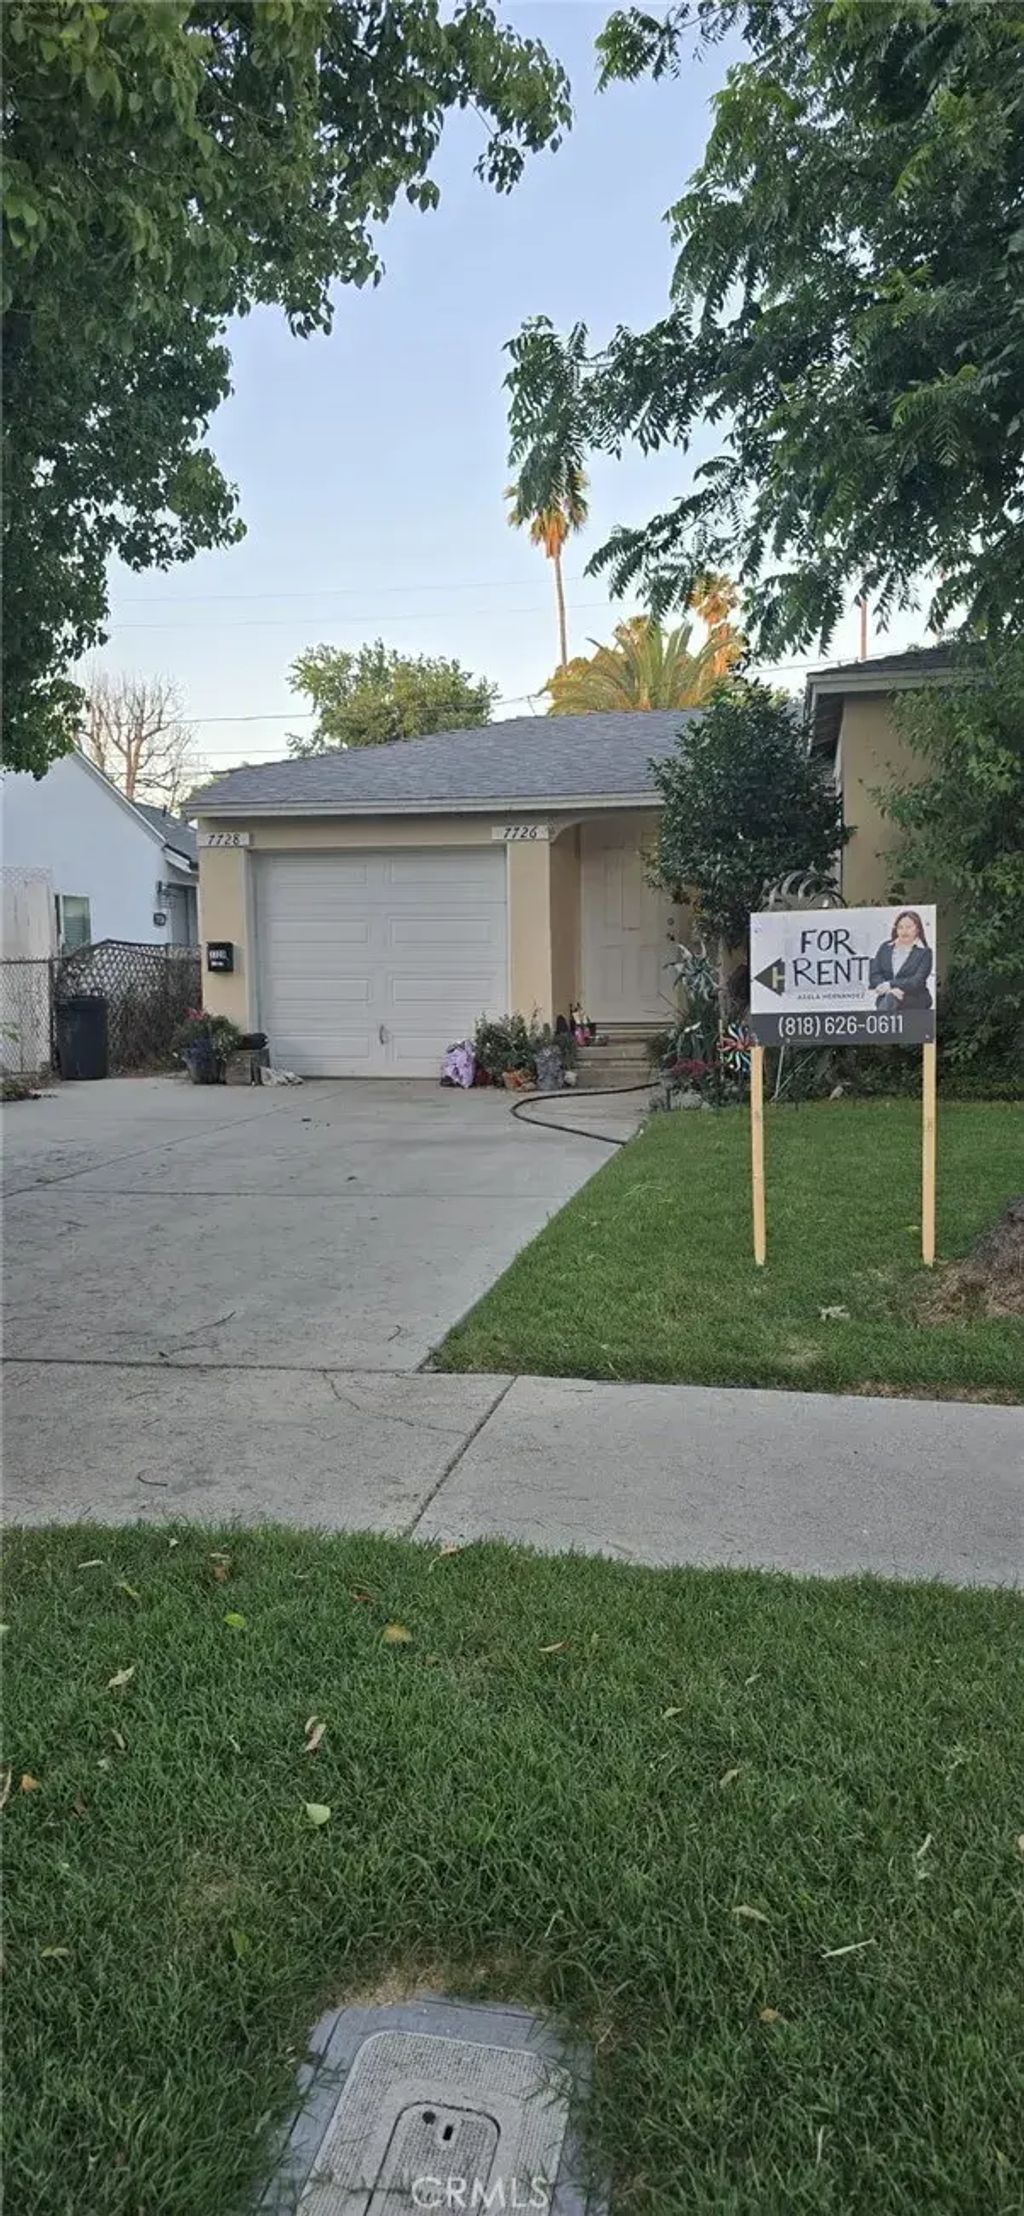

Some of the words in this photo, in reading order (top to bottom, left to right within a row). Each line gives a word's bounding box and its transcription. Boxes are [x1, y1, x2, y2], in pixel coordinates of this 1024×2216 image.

[208, 833, 241, 847] 7728
[504, 826, 537, 839] 7726
[800, 929, 857, 955] FOR
[792, 956, 870, 986] RENT
[778, 1015, 821, 1038] (818)
[824, 1015, 903, 1035] 626-0611
